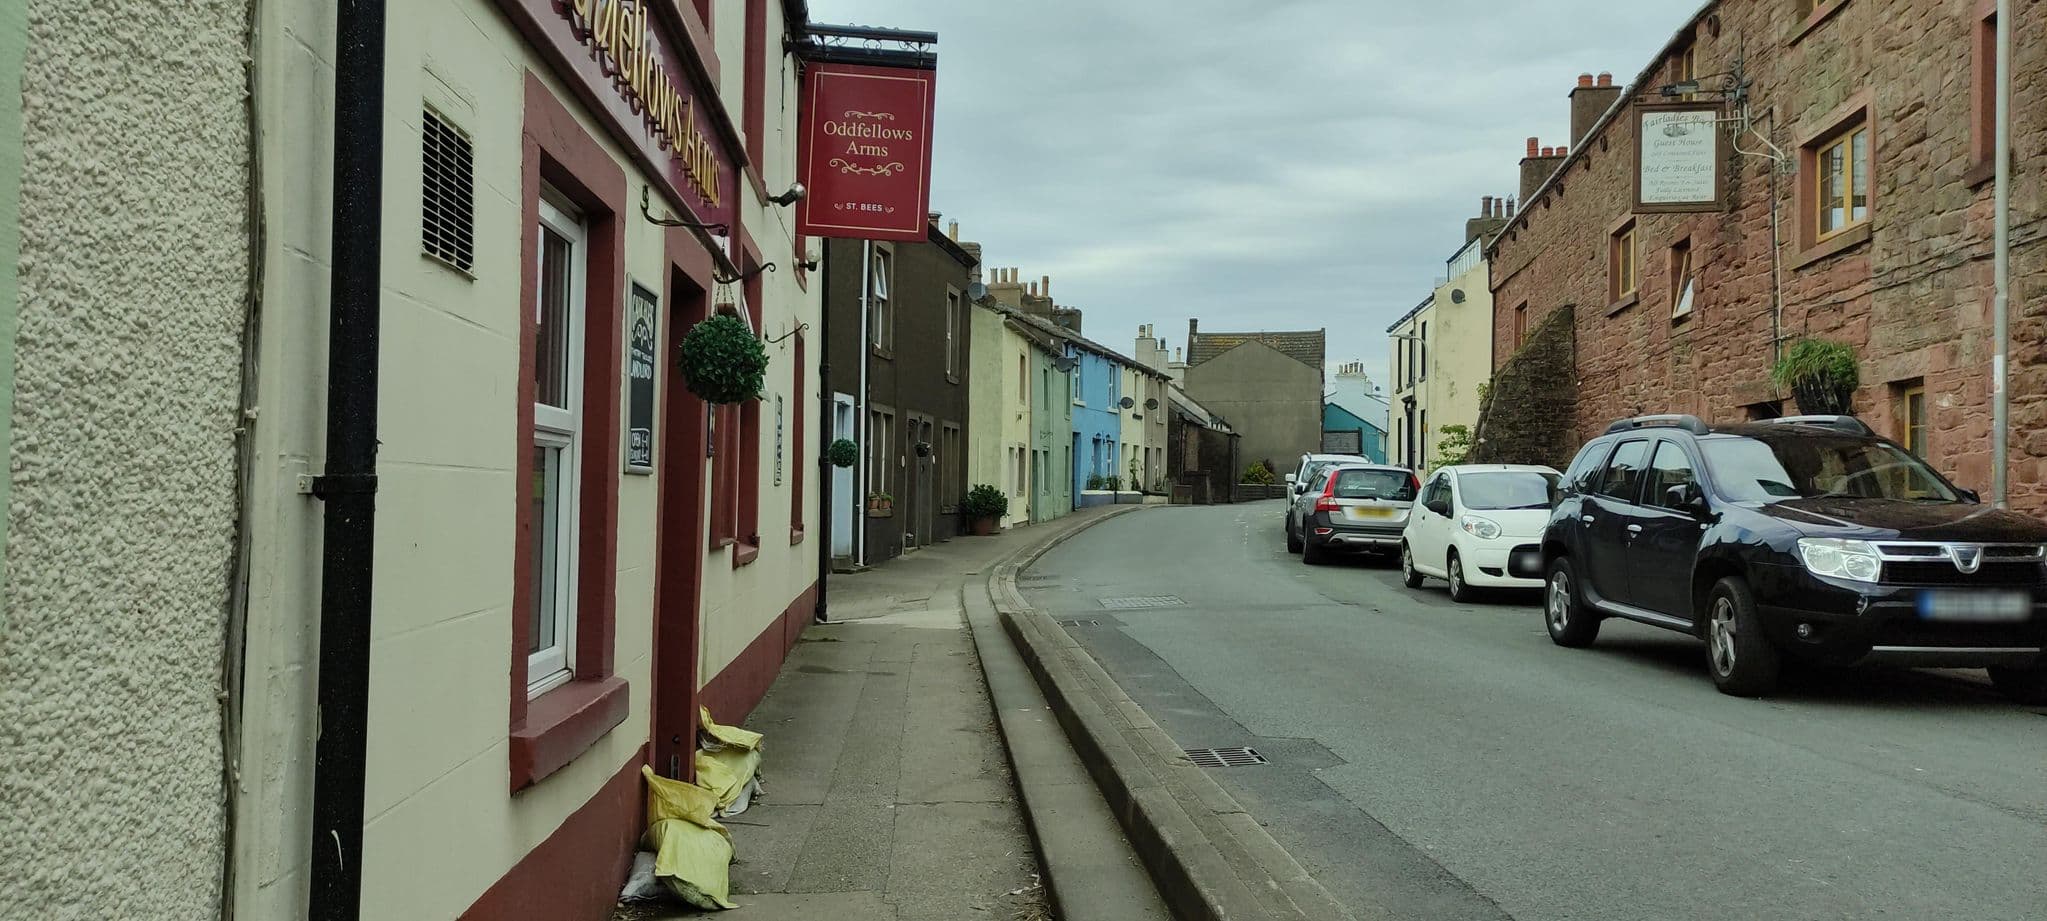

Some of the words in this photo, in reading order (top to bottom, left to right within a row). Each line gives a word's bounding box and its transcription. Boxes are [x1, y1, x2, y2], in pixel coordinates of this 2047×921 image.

[574, 0, 682, 153] fellows
[684, 95, 721, 209] Arms
[823, 120, 913, 141] Oddfellows
[846, 140, 889, 157] Arms
[1654, 139, 1676, 148] Guest
[1678, 138, 1703, 146] House
[1643, 165, 1659, 173] Bed
[1673, 163, 1712, 174] Breakfast
[846, 202, 859, 211] ST.
[860, 203, 883, 212] BEES
